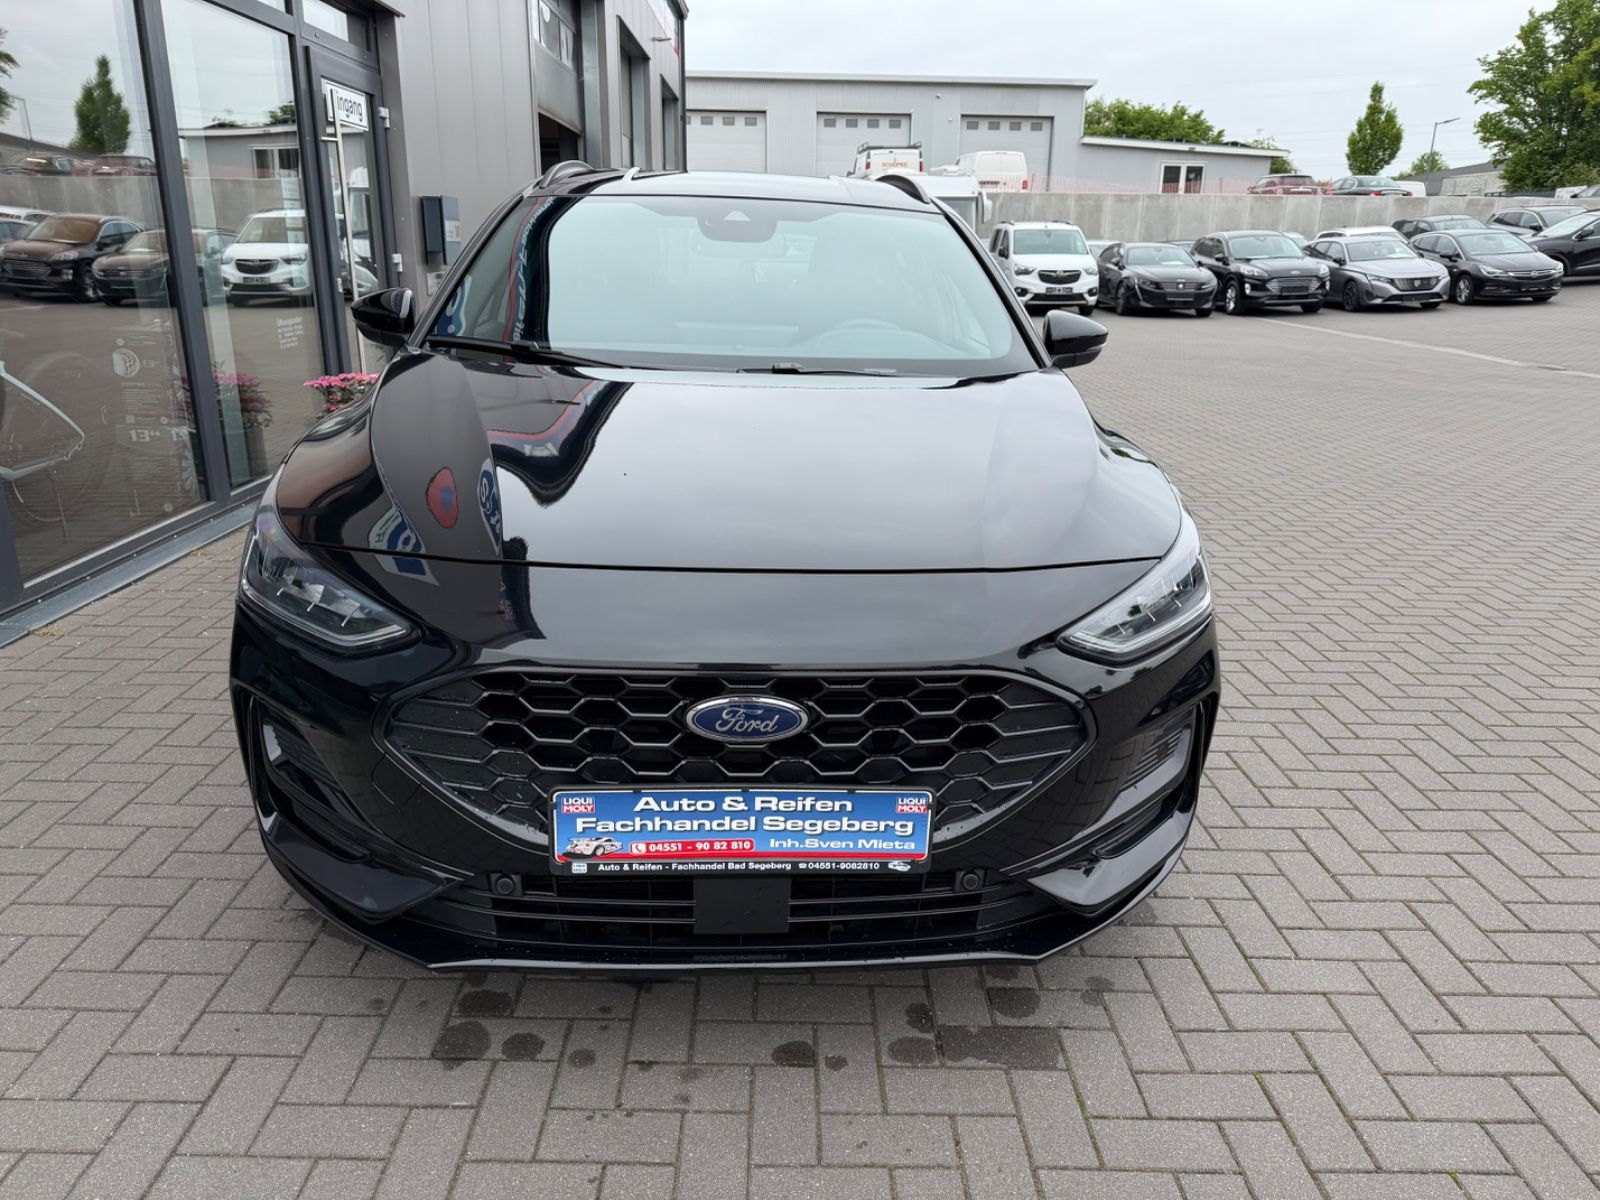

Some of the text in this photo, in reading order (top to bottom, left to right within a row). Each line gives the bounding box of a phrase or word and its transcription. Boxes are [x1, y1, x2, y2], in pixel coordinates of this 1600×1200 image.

[334, 90, 363, 123] ingang
[715, 706, 780, 732] Ford
[563, 797, 593, 805] LIQUI
[633, 796, 853, 812] Auto & Reifen
[898, 797, 927, 805] LIQUI
[563, 805, 594, 813] MOLY
[897, 805, 926, 813] MOLY
[576, 816, 914, 836] Fachhandel Segeberg
[649, 843, 682, 852] 04551
[696, 842, 710, 850] 90
[713, 841, 727, 850] 82
[731, 841, 750, 849] 810
[858, 839, 915, 850] Mieta
[598, 863, 620, 871] Auto
[623, 863, 630, 871] &
[633, 863, 663, 871] Reifen
[672, 862, 725, 870] Fachhandel
[728, 862, 746, 870] Bad
[748, 862, 792, 871] Segeberg
